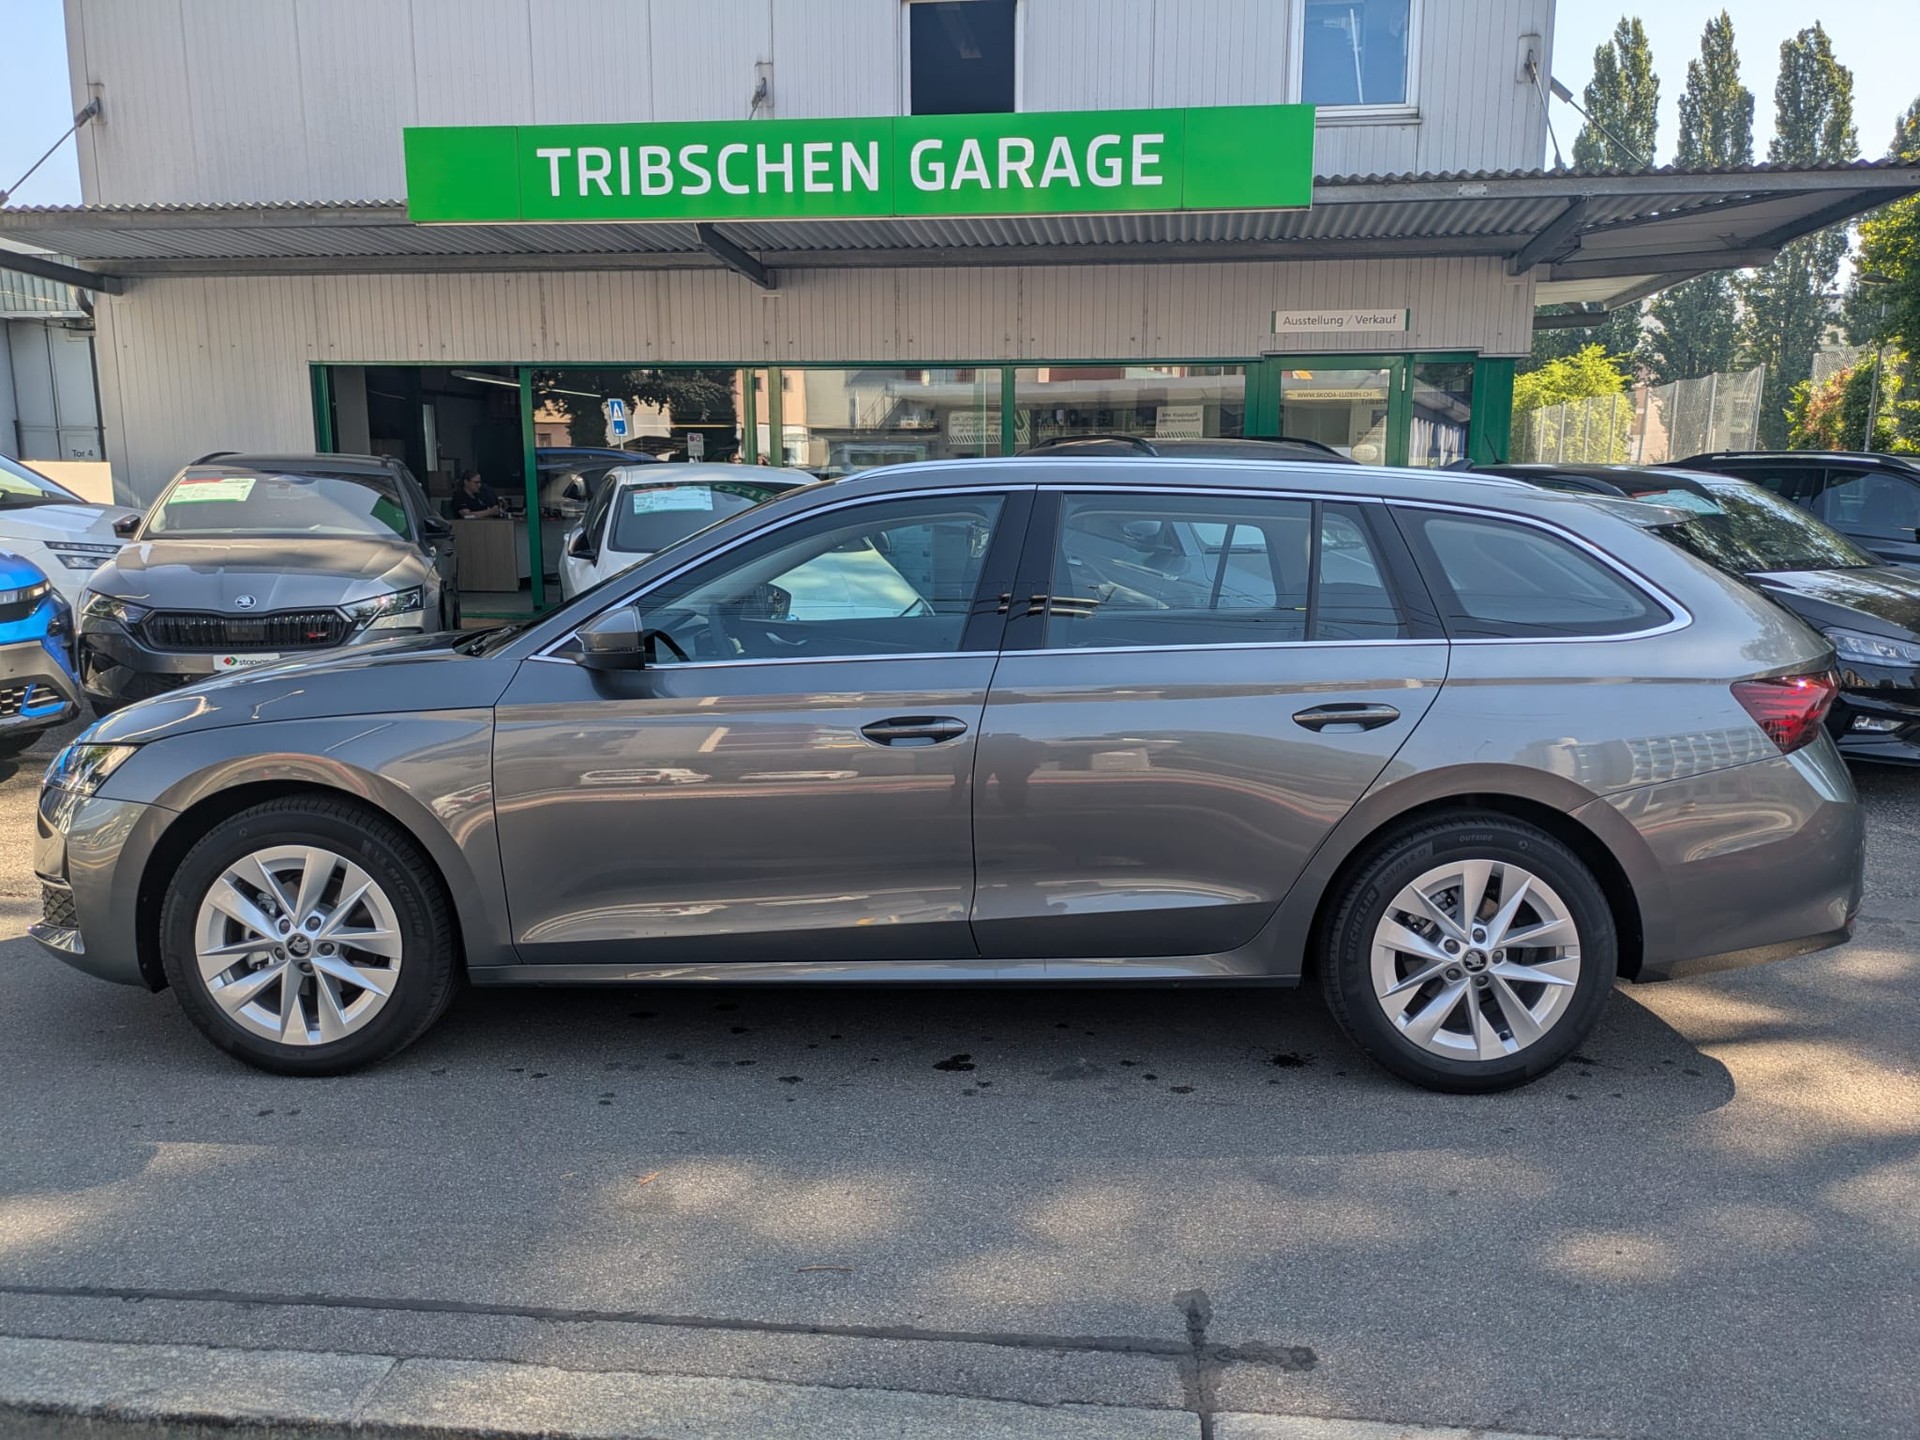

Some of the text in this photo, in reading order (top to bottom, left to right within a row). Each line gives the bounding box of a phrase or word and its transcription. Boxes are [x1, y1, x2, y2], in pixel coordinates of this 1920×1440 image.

[536, 133, 1164, 196] TRIBSCHEN GARAGE
[1283, 313, 1398, 327] Ausstellung / Verkauf
[72, 449, 94, 458] Tor 4
[1346, 889, 1378, 962] MICHELIN
